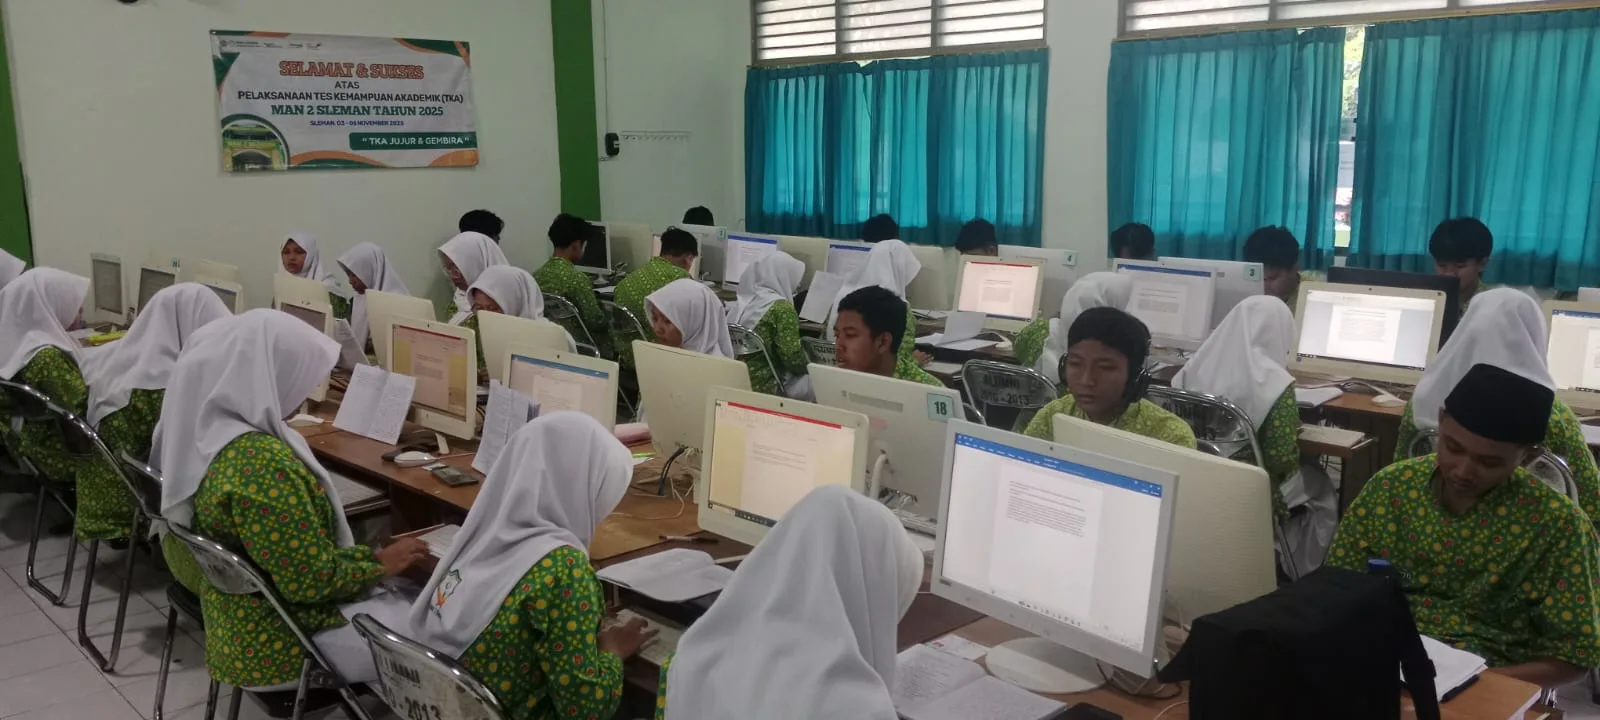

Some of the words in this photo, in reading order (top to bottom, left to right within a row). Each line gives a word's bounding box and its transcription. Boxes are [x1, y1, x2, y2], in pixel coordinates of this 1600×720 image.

[279, 60, 355, 78] SELAMAT
[356, 63, 369, 79] &
[370, 63, 424, 80] SUKSES
[334, 81, 360, 89] ATAS
[238, 91, 313, 101] PELAKSANAAN
[314, 92, 332, 101] TES
[333, 92, 394, 102] KEMAMPUAN
[394, 93, 441, 102] AKADEMIK
[441, 93, 464, 103] (TKA)
[271, 104, 305, 115] MAN
[307, 105, 314, 115] 2
[316, 105, 369, 115] SLEMAN
[372, 105, 417, 116] TAHUN
[418, 106, 444, 116] 2025
[369, 137, 388, 145] TKA
[389, 137, 416, 145] JUJUR
[425, 136, 464, 145] GEMBIRA
[934, 401, 948, 416] 18
